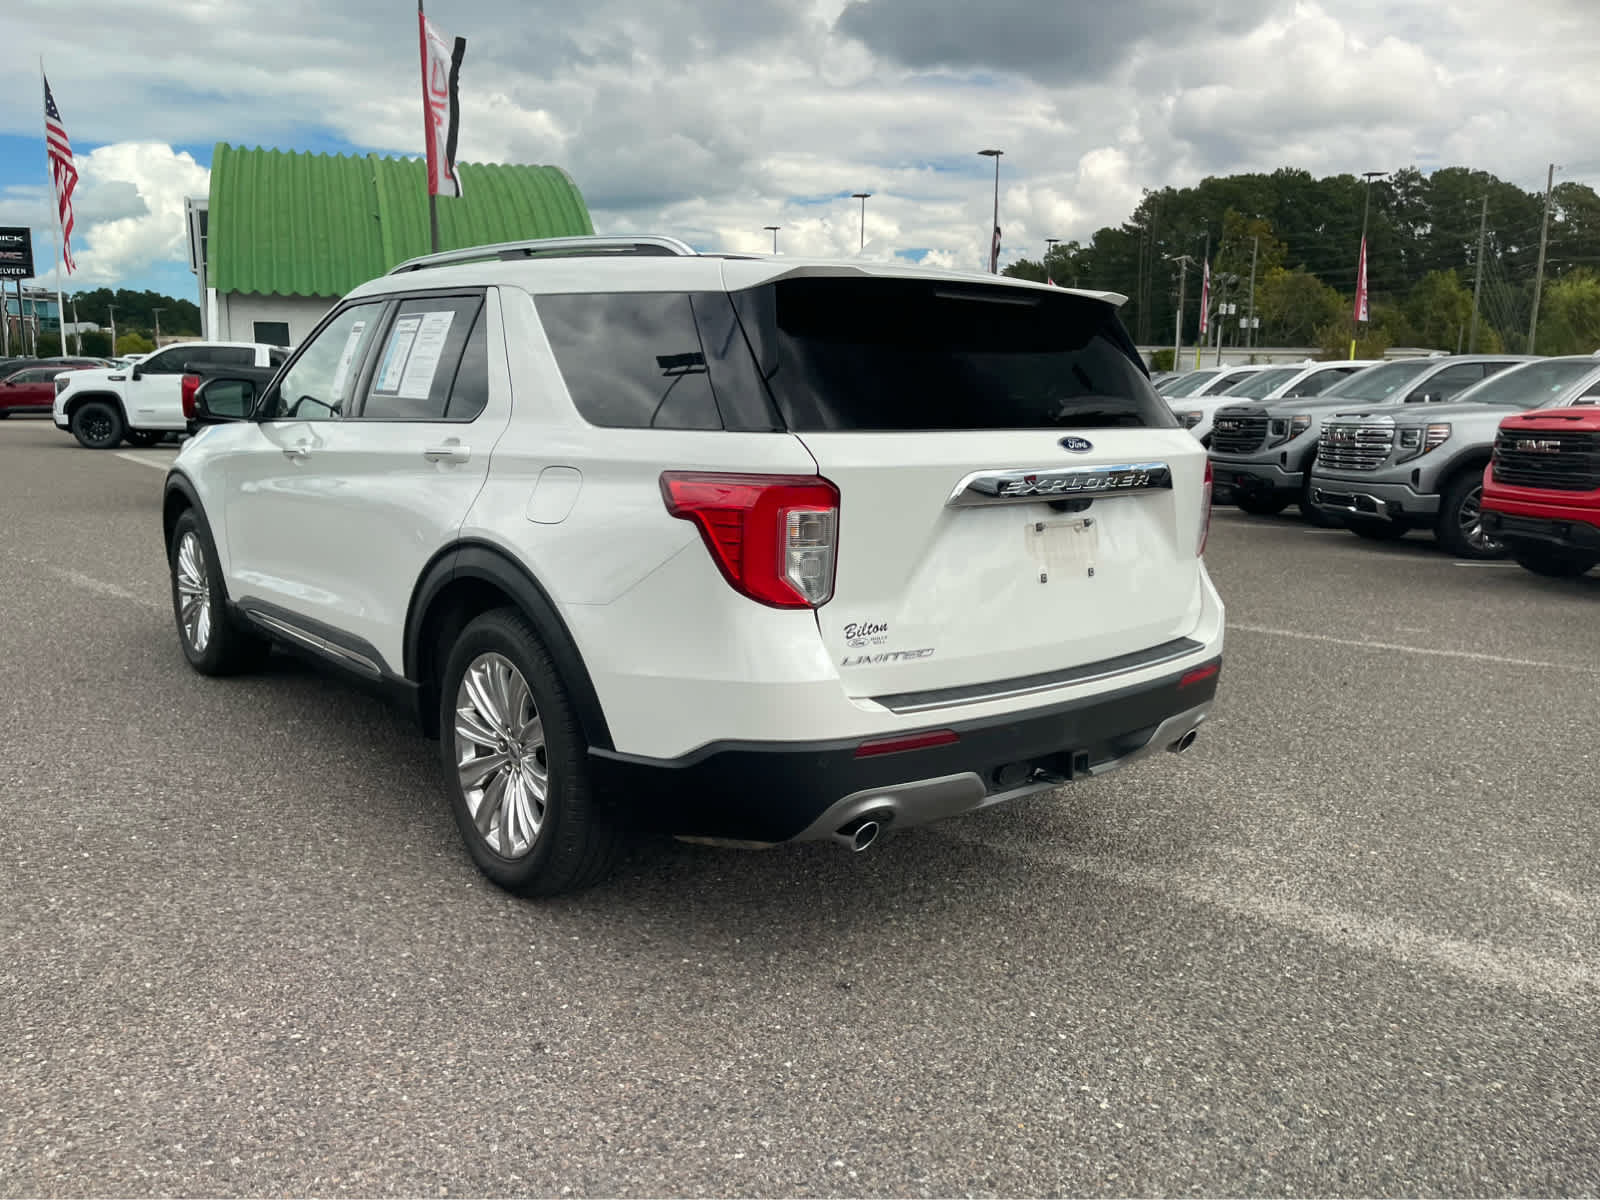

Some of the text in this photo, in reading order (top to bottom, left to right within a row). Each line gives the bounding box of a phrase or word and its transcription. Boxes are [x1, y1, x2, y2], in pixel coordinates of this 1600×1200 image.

[1516, 439, 1561, 453] GMC
[1000, 474, 1150, 495] EXPLORER
[843, 622, 888, 640] Bilton
[840, 648, 935, 666] LIMITED
